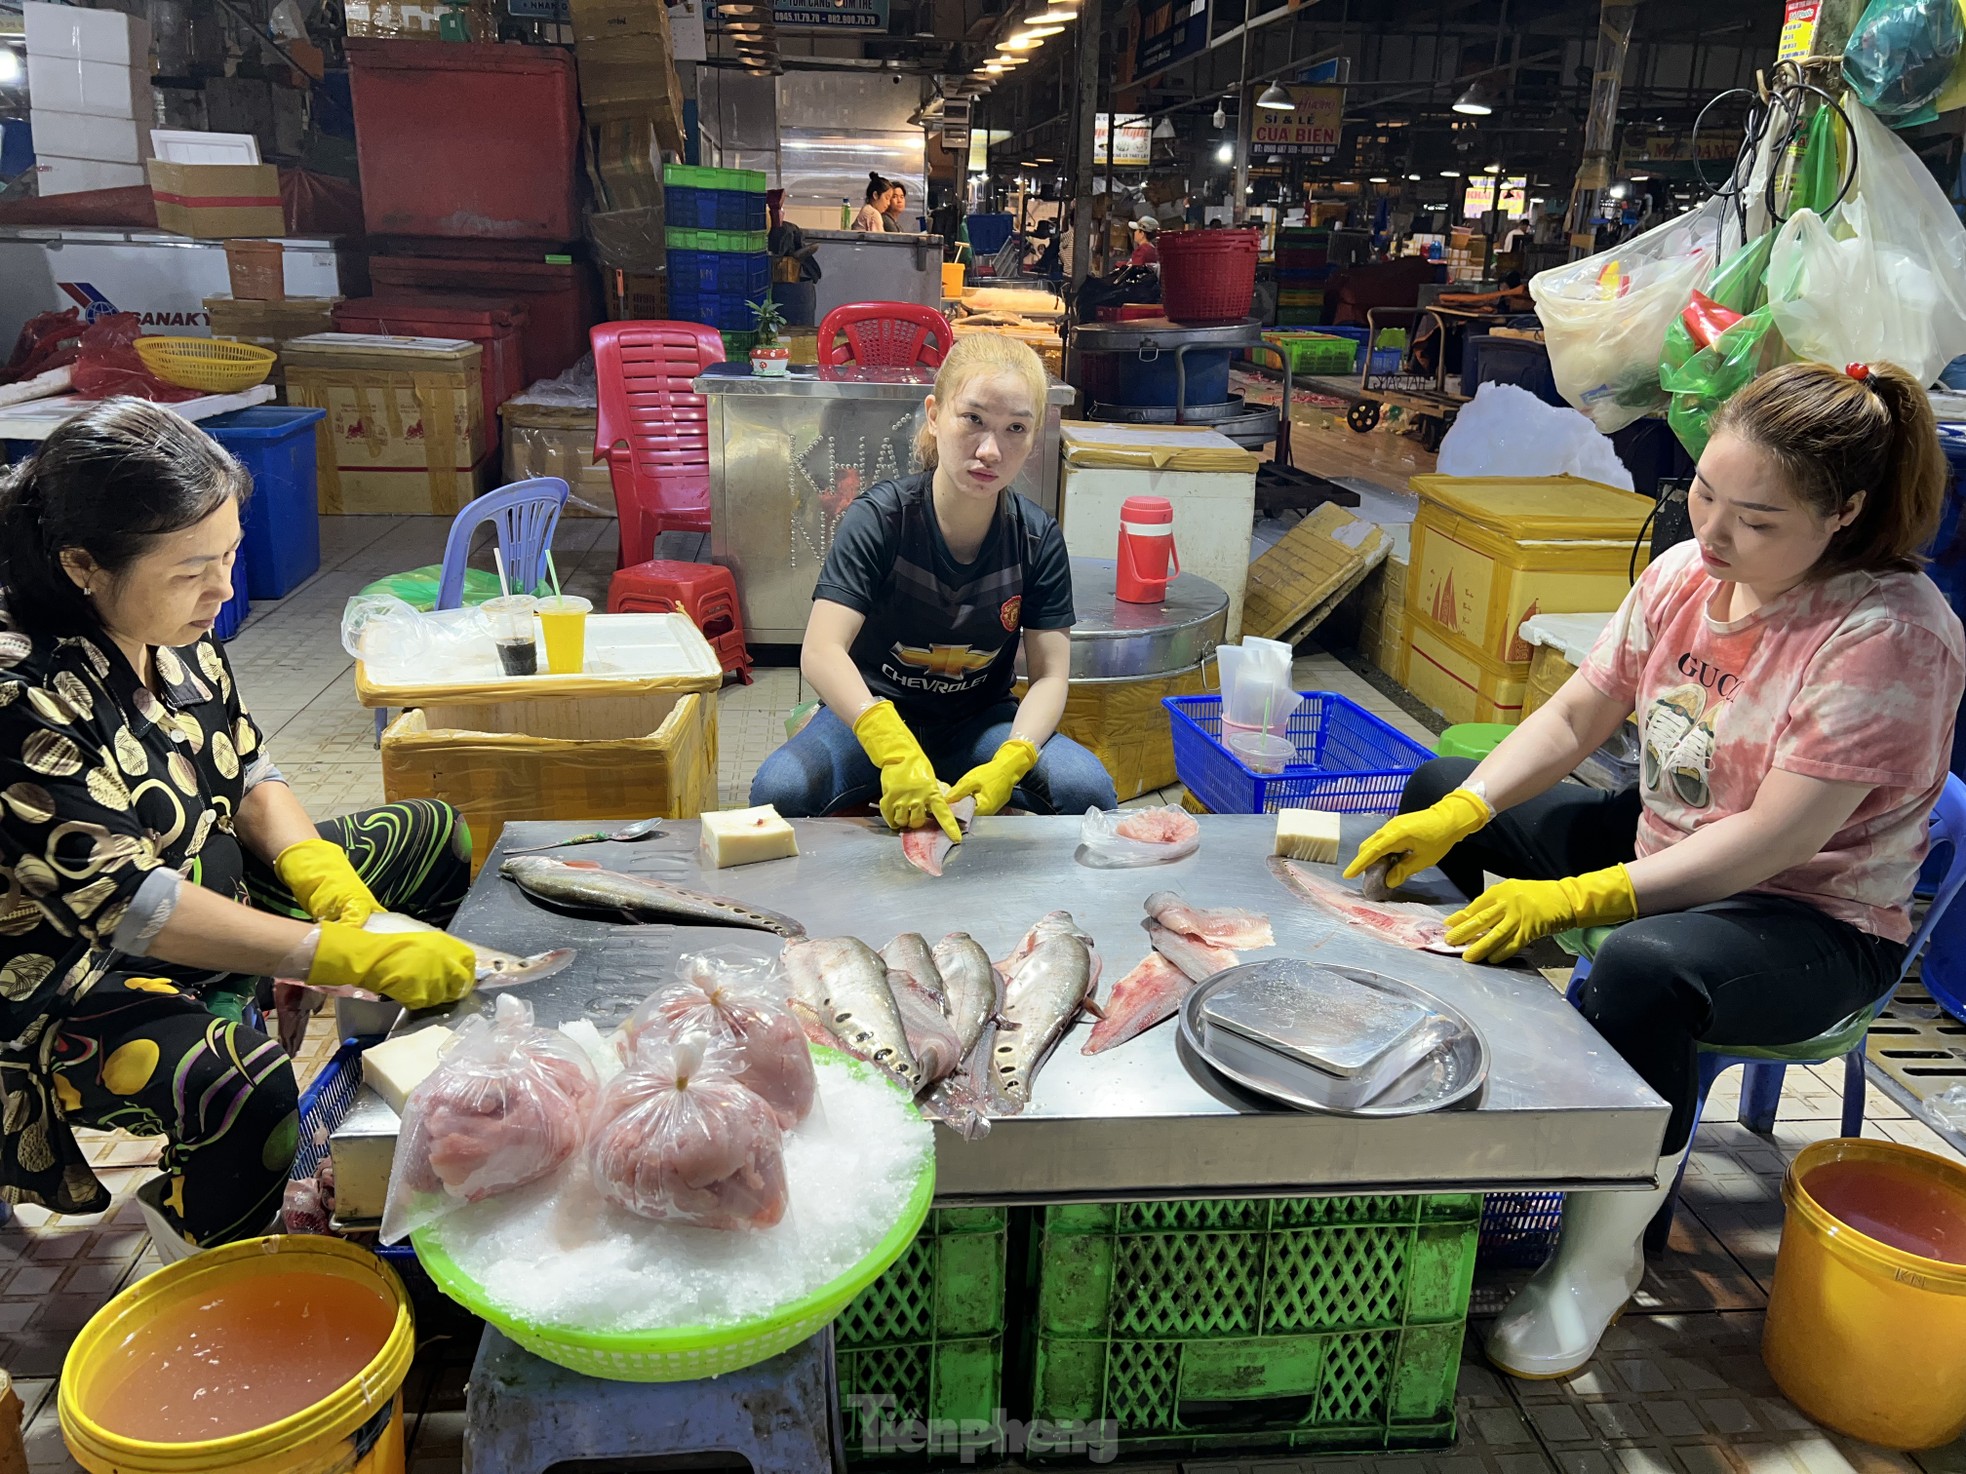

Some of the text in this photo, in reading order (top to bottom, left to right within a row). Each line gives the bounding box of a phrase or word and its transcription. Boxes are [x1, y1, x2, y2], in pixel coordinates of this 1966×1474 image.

[1283, 115, 1293, 124] &
[1256, 127, 1289, 141] CUA
[881, 662, 989, 695] CHEVROLET
